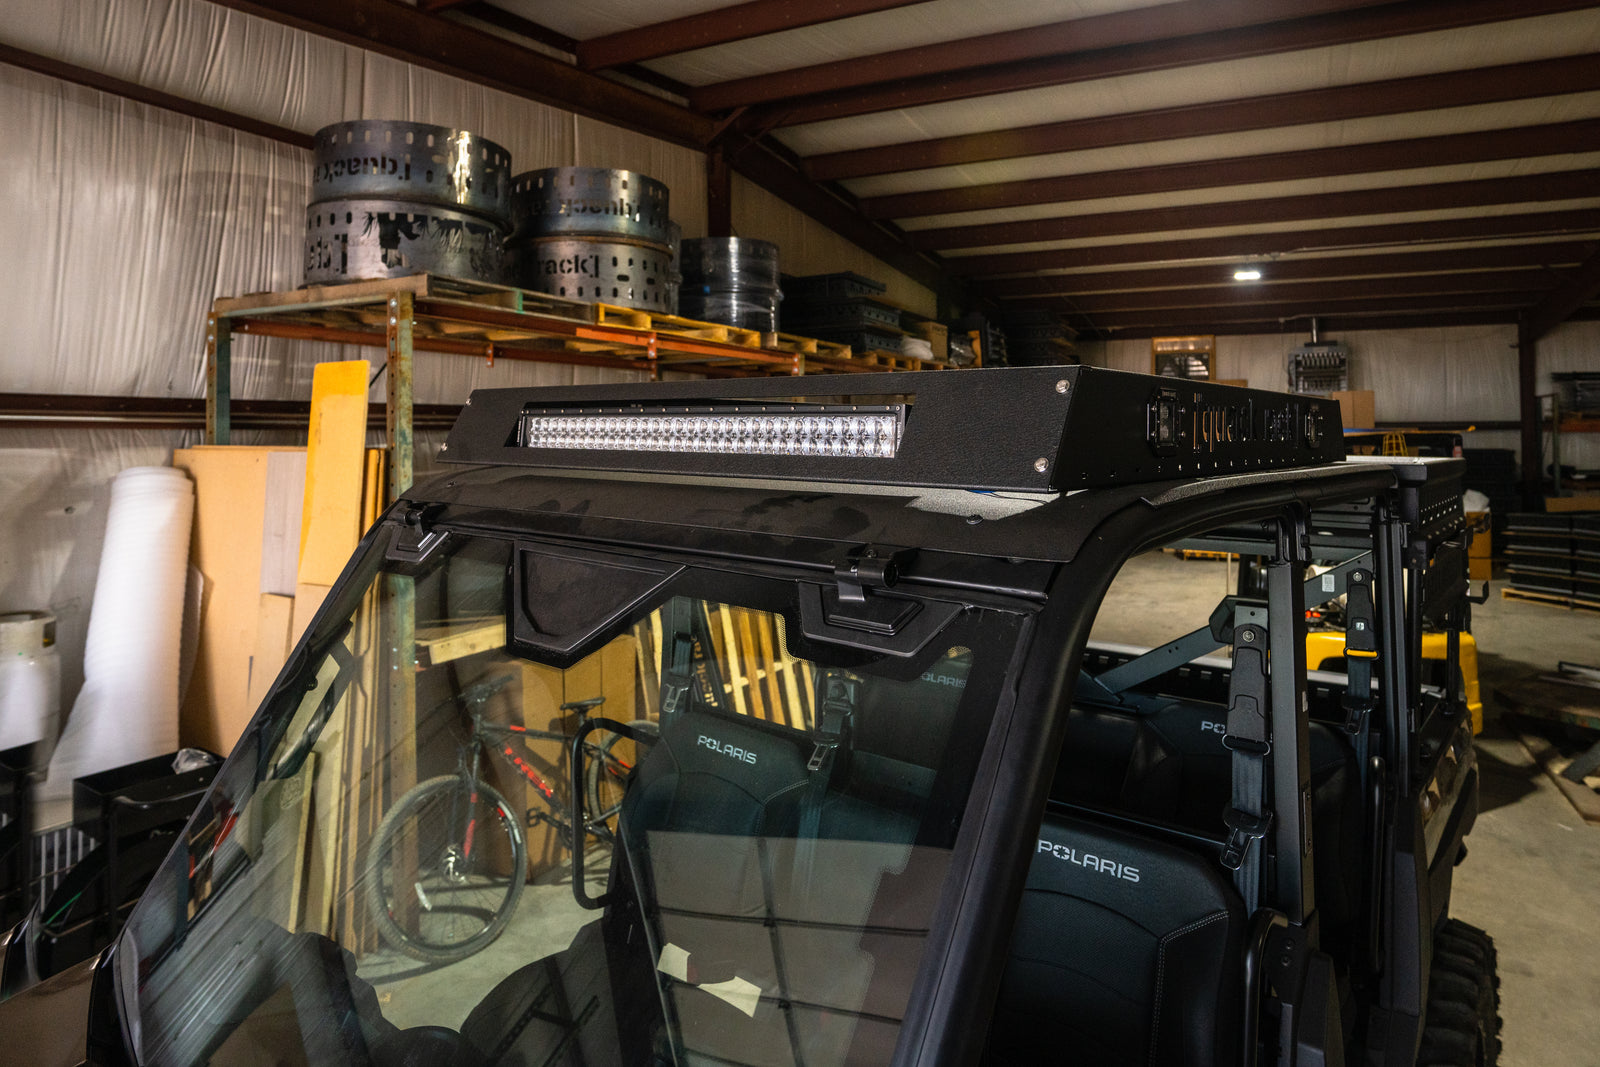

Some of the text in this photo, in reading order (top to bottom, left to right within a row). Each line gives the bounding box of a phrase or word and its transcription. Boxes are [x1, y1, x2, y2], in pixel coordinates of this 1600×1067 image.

[920, 671, 967, 689] OLARIS
[697, 735, 758, 765] POLARIS
[1037, 839, 1140, 883] POLARIS
